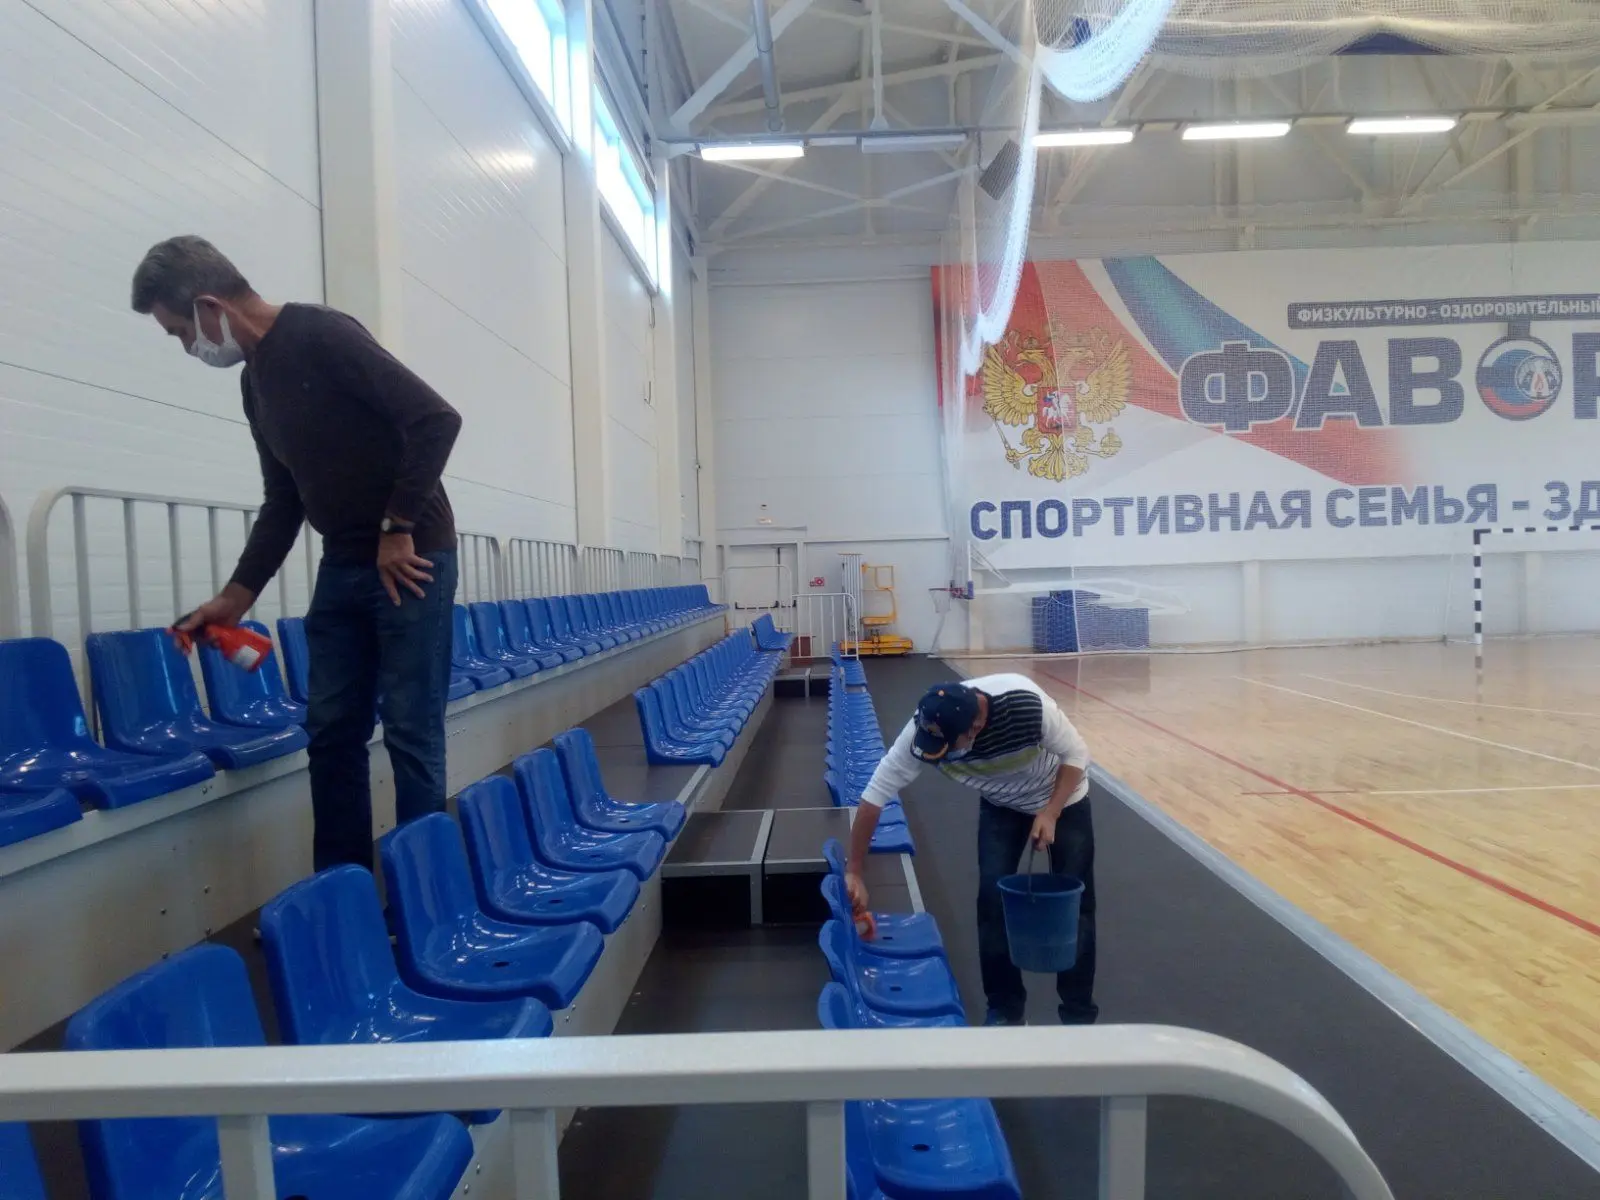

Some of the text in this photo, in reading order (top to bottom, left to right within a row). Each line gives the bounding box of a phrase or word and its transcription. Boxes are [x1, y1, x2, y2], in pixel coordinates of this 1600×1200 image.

[1298, 305, 1427, 321] ФИЗКУЛЬТУРНО
[1440, 300, 1600, 319] ОЗДОРОВИТЕЛЬНЫ
[970, 489, 1312, 540] СПОРТИВНАЯ
[1325, 483, 1498, 528] СЕМЬЯ
